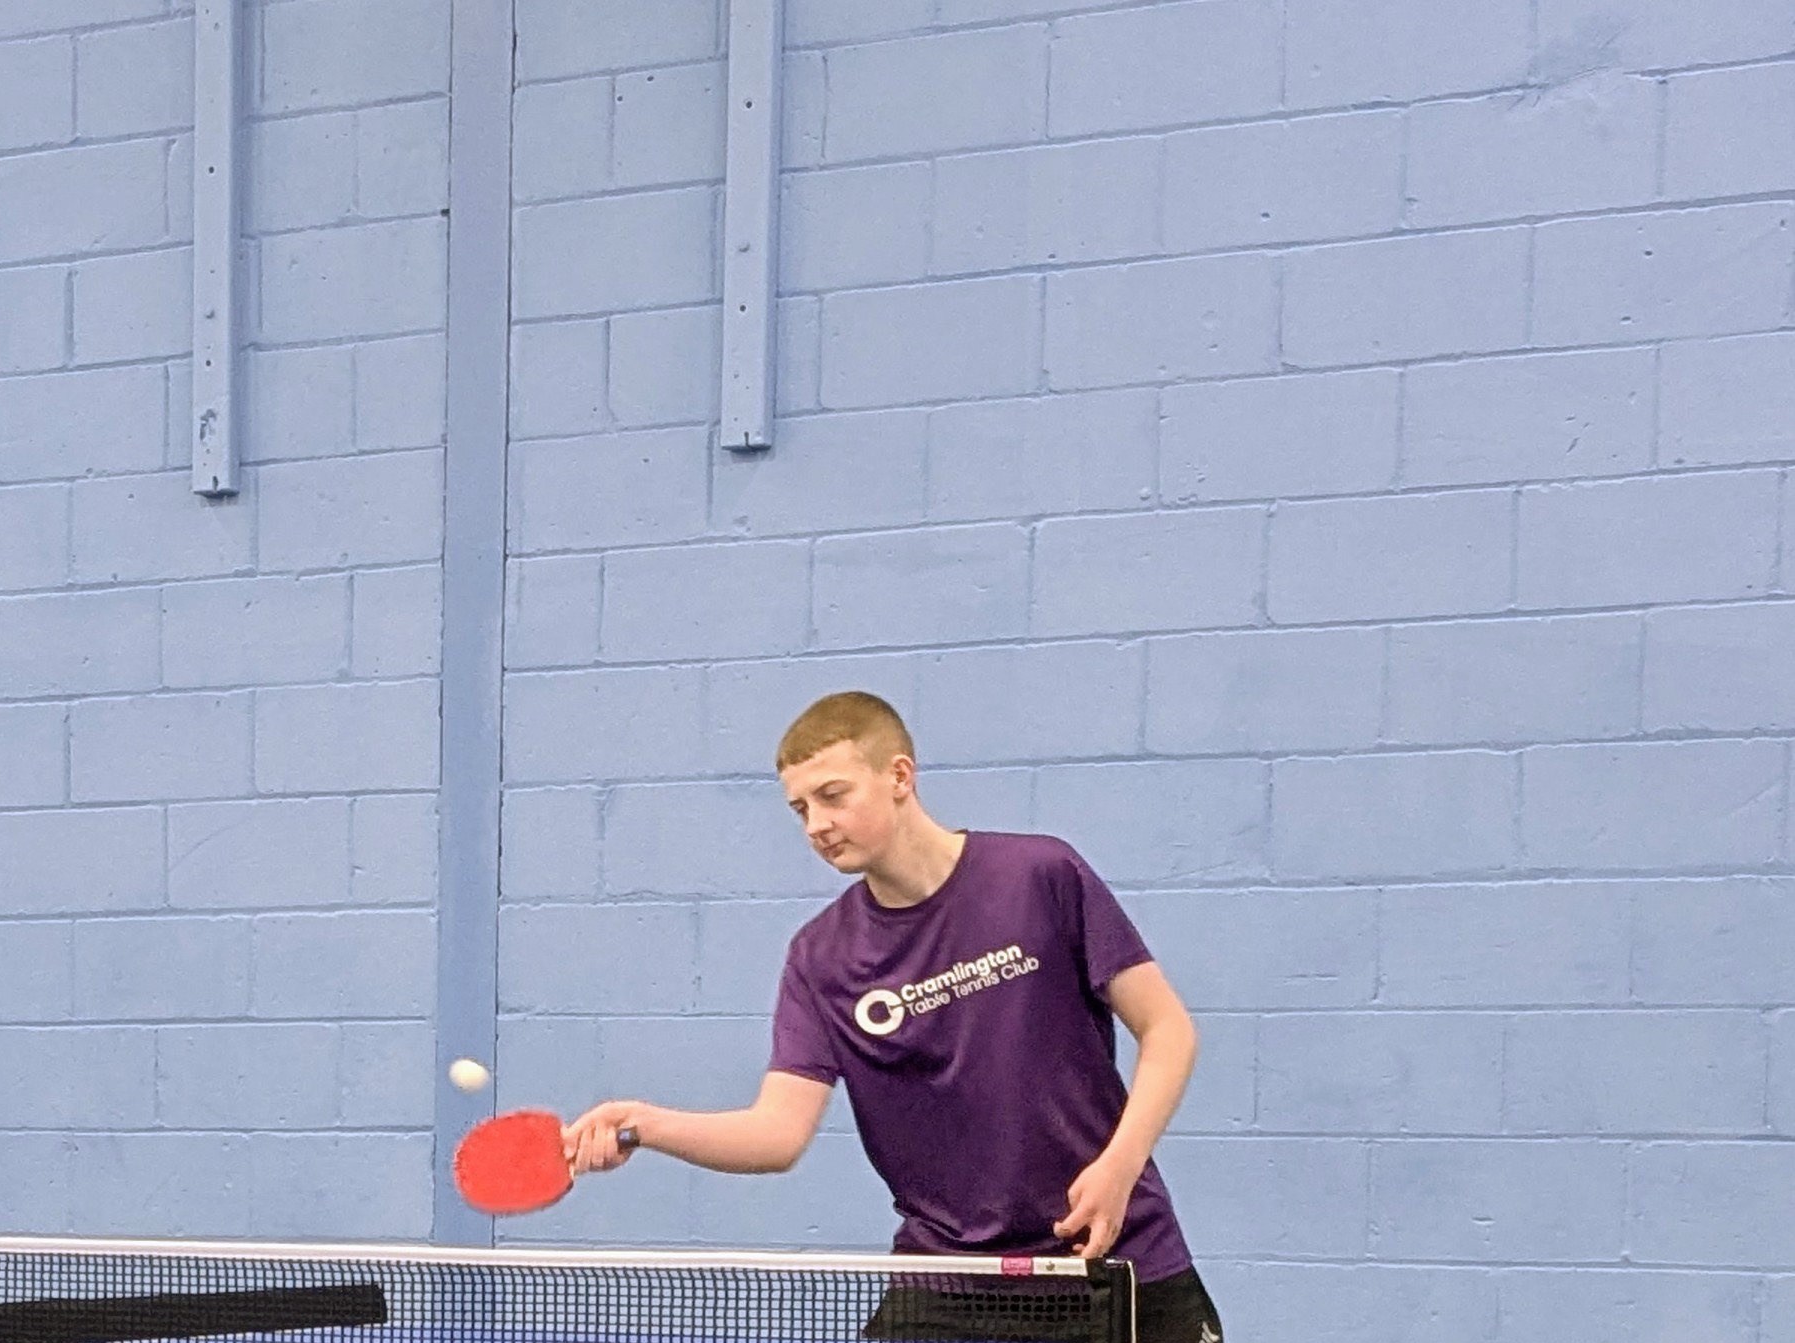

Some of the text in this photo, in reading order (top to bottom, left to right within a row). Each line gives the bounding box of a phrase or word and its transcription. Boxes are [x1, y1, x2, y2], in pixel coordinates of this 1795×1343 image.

[901, 944, 1023, 1002] Cramlington
[906, 955, 1039, 1017] Table Tennis Club
